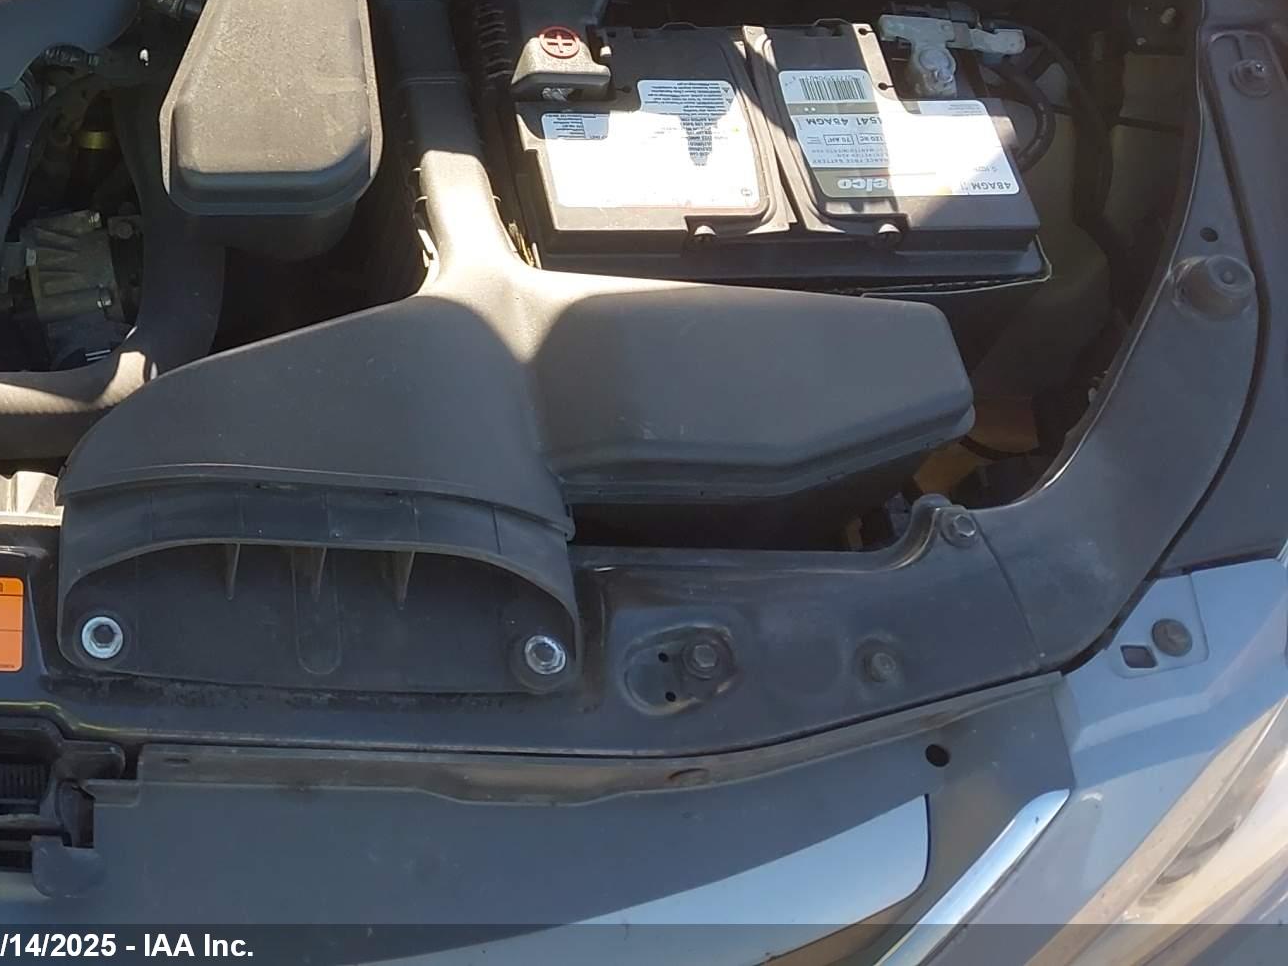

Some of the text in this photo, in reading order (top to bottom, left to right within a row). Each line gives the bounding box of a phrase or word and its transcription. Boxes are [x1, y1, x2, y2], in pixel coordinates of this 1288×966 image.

[805, 117, 849, 126] 48AGM
[837, 178, 888, 192] elco
[970, 181, 1012, 190] 48AGM
